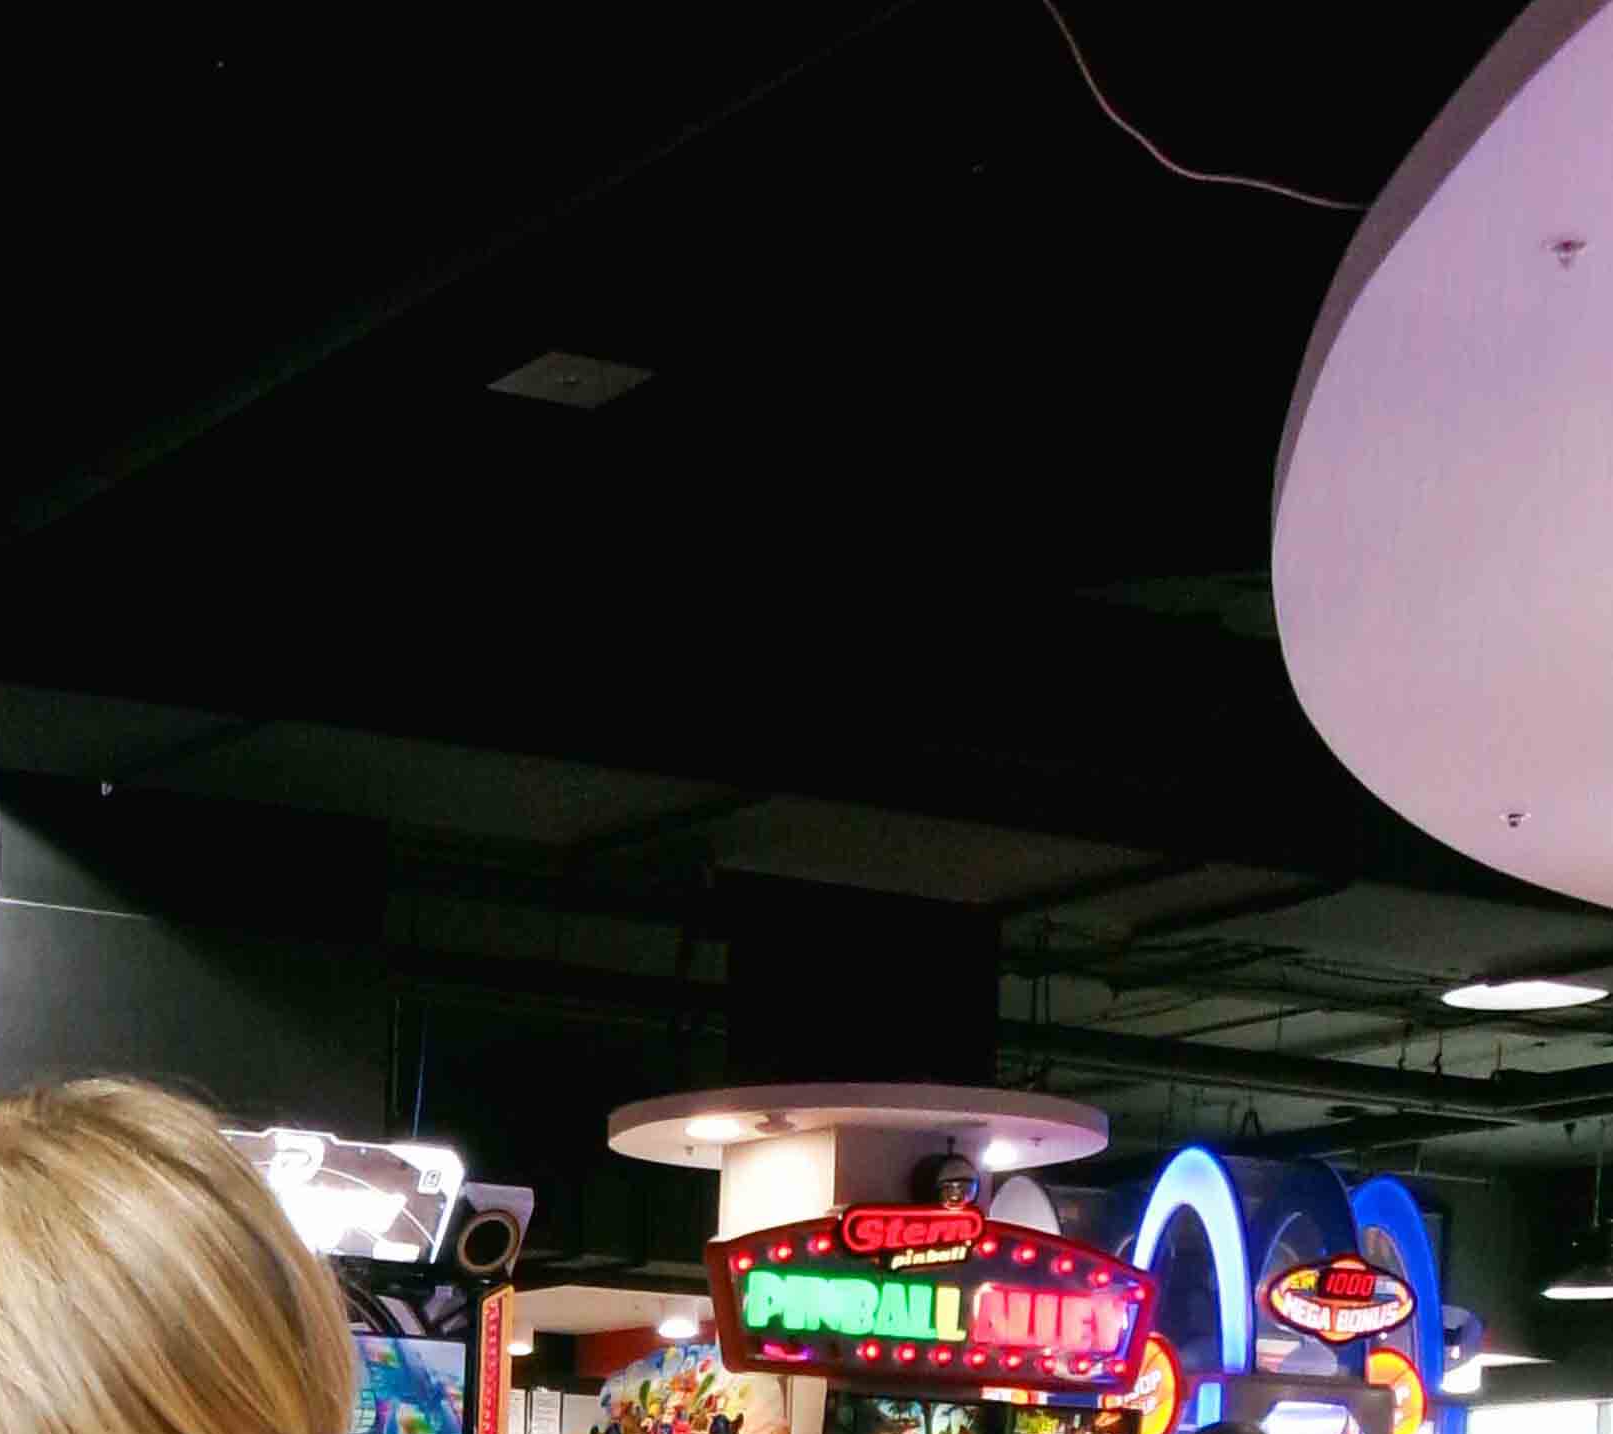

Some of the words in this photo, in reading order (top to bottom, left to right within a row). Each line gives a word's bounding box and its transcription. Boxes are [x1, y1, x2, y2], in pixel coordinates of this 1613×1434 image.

[853, 1215, 975, 1248] Stern
[890, 1244, 968, 1270] pinball
[1326, 1272, 1376, 1297] 1000
[745, 1270, 967, 1342] PINBALL
[973, 1283, 1129, 1352] ALLEY
[1283, 1292, 1332, 1331] MEGA
[1336, 1302, 1400, 1332] BONUS
